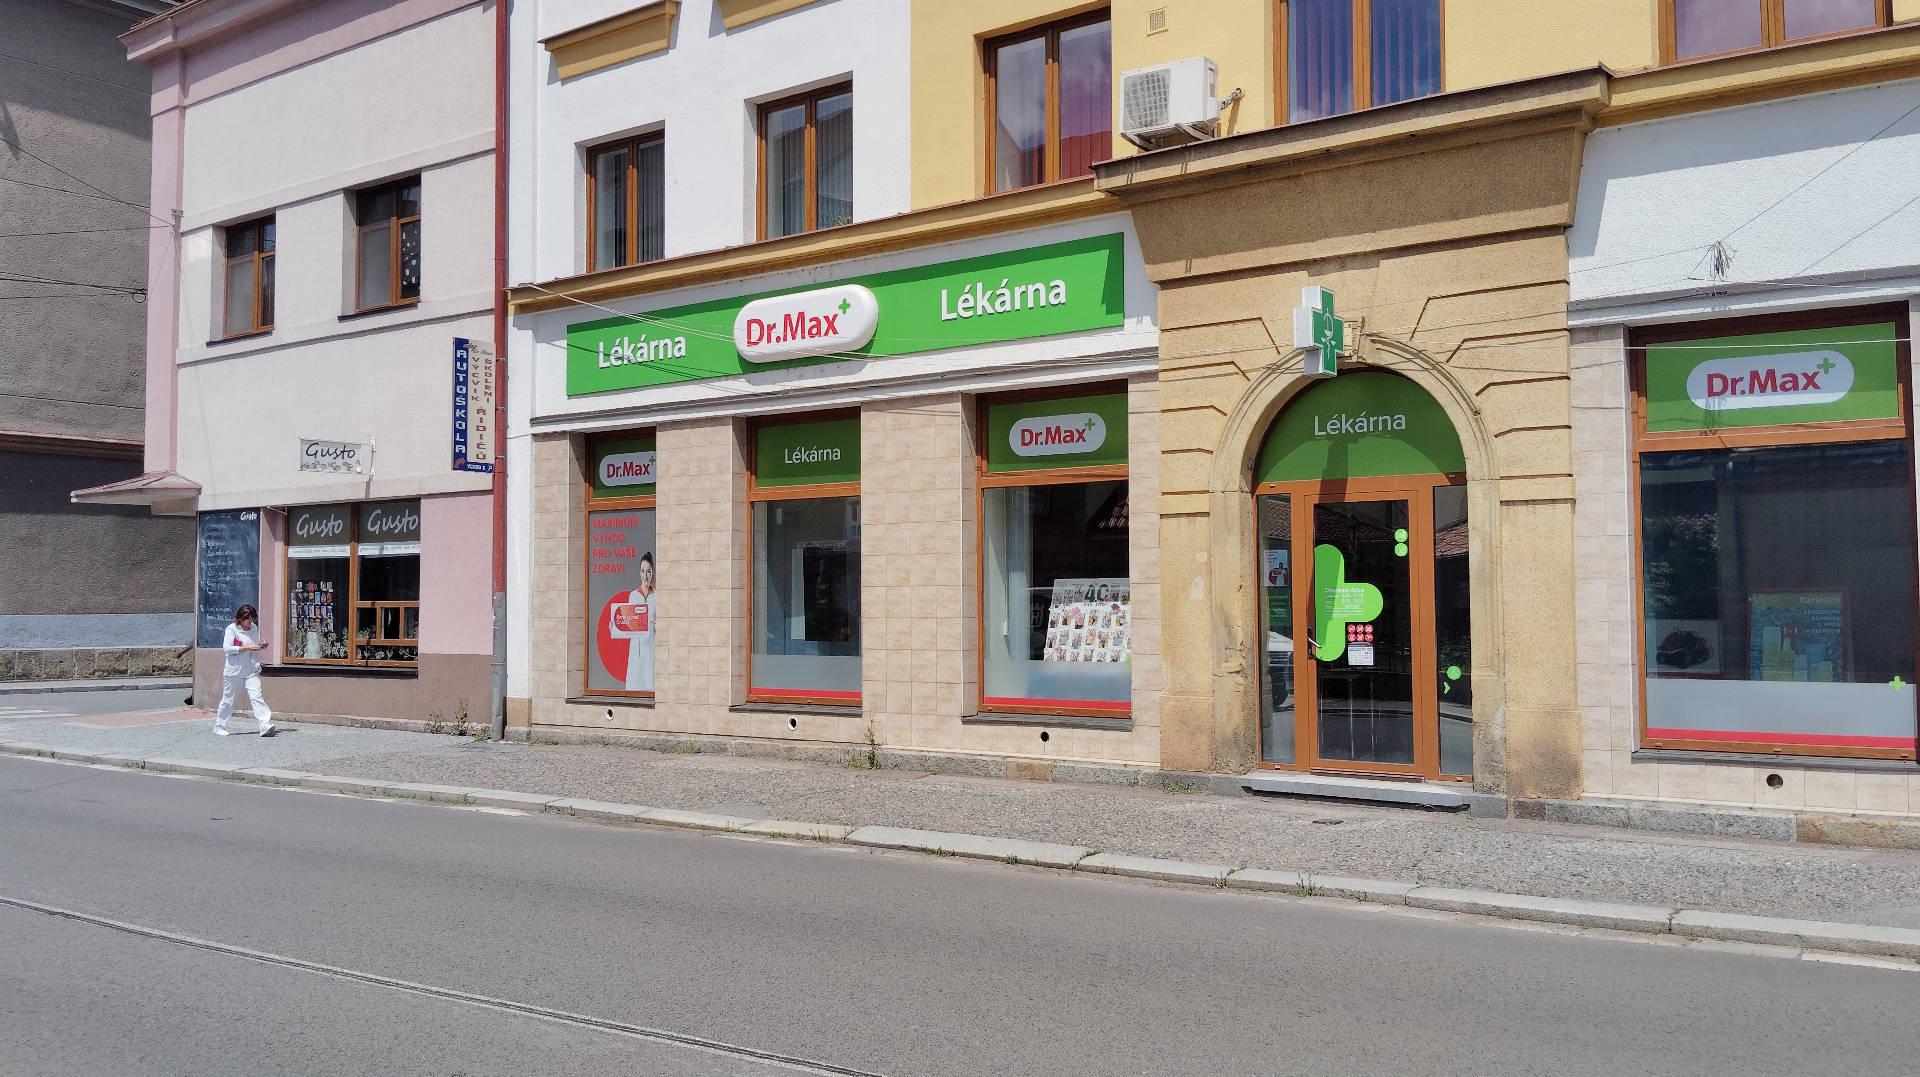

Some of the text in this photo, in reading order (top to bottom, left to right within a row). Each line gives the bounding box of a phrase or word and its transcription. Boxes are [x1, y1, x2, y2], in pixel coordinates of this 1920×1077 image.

[942, 278, 1067, 321] Lékárna
[746, 312, 838, 347] Dr.Max
[599, 335, 686, 368] Lékárna
[1709, 370, 1820, 396] Dr.Max
[455, 349, 467, 454] AUTOŠKOLA
[1021, 425, 1086, 447] Dr.Max
[1314, 411, 1406, 437] Lékárna
[305, 443, 356, 460] Gusto
[784, 445, 841, 464] Lékárna
[607, 462, 650, 479] Dr.Max
[240, 511, 258, 521] Gusto
[296, 513, 344, 538] Gusto
[367, 509, 419, 535] Gusto
[592, 516, 639, 528] MAXIMUM
[592, 548, 611, 559] PRO
